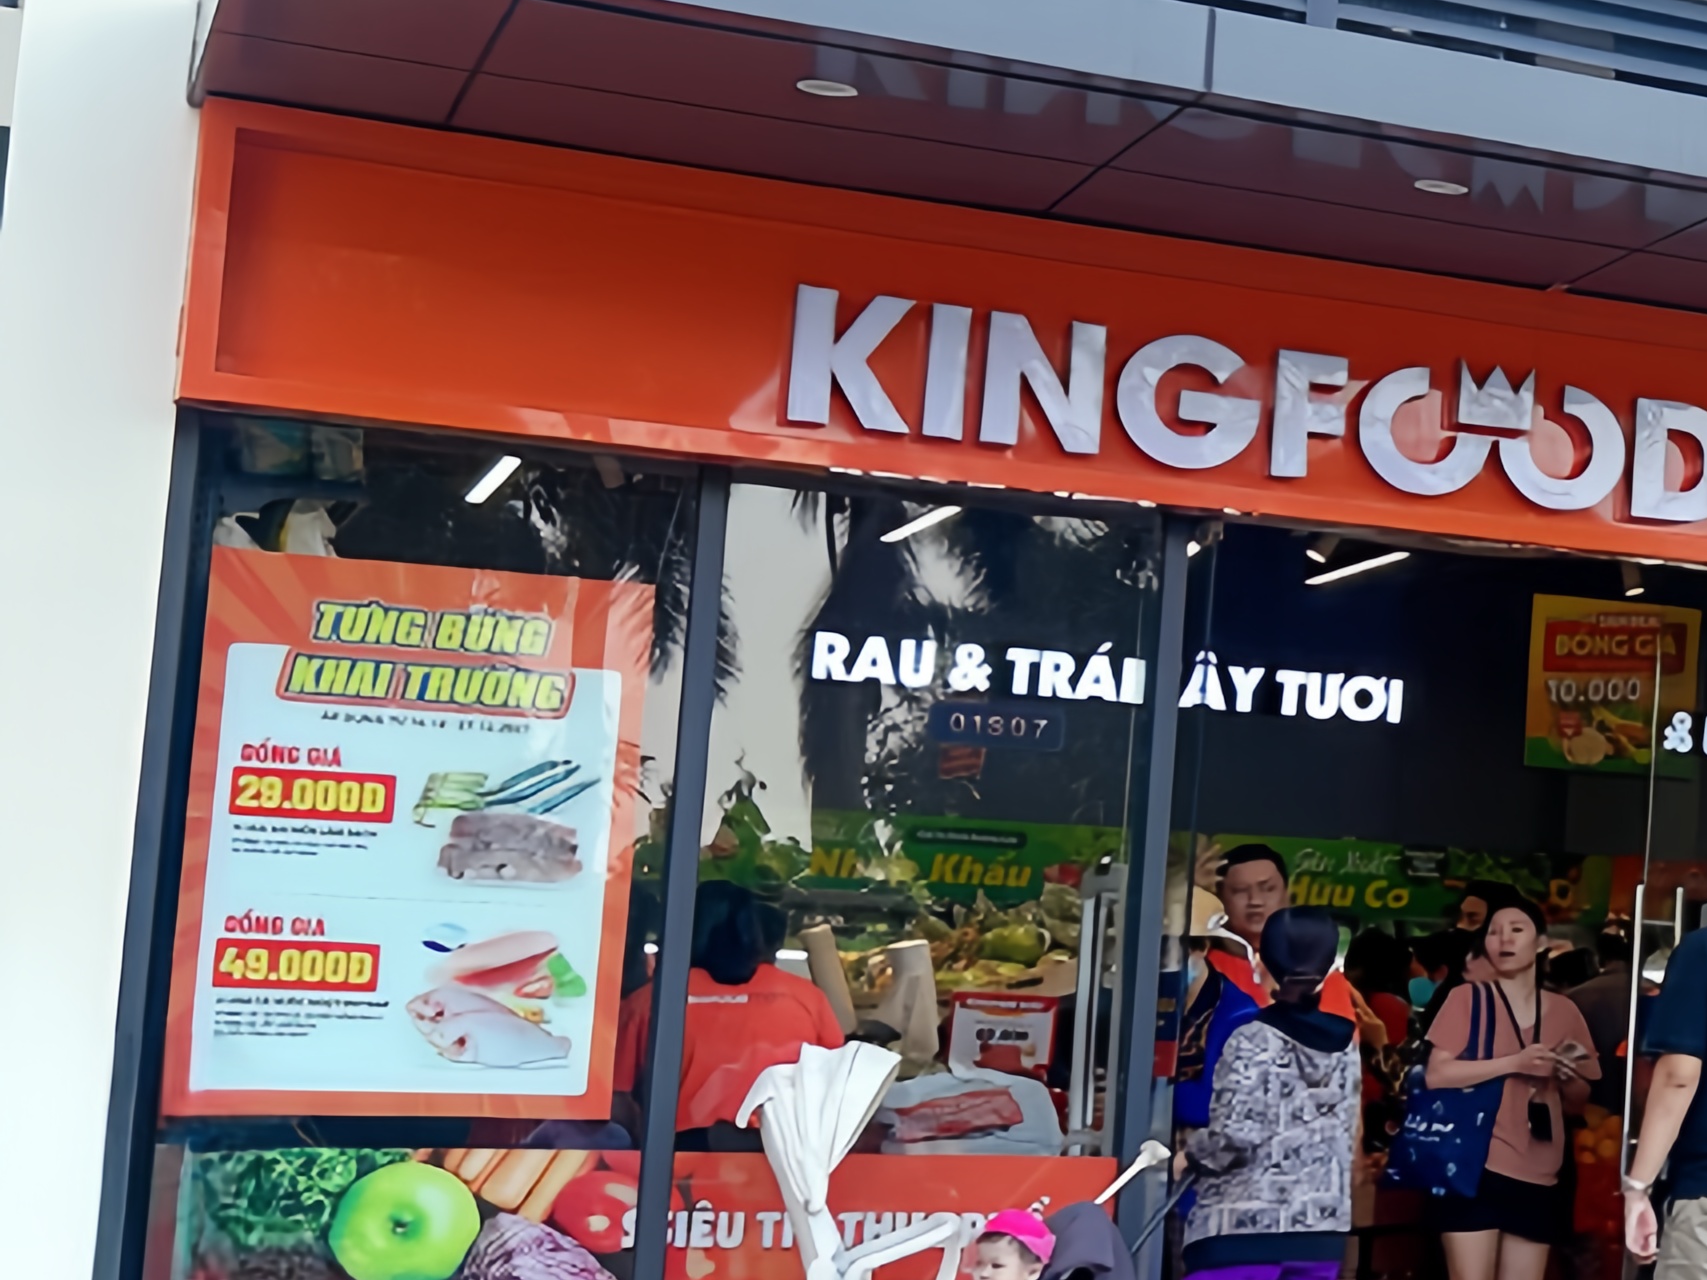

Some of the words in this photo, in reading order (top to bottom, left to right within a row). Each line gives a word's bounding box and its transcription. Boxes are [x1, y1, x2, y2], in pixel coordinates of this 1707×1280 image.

[288, 655, 393, 697] KHAI
[812, 631, 935, 688] RAU
[947, 643, 993, 692] &
[1005, 641, 1147, 705] TRÁI
[1178, 651, 1266, 713] ÂY
[1275, 667, 1404, 724] TƯƠI
